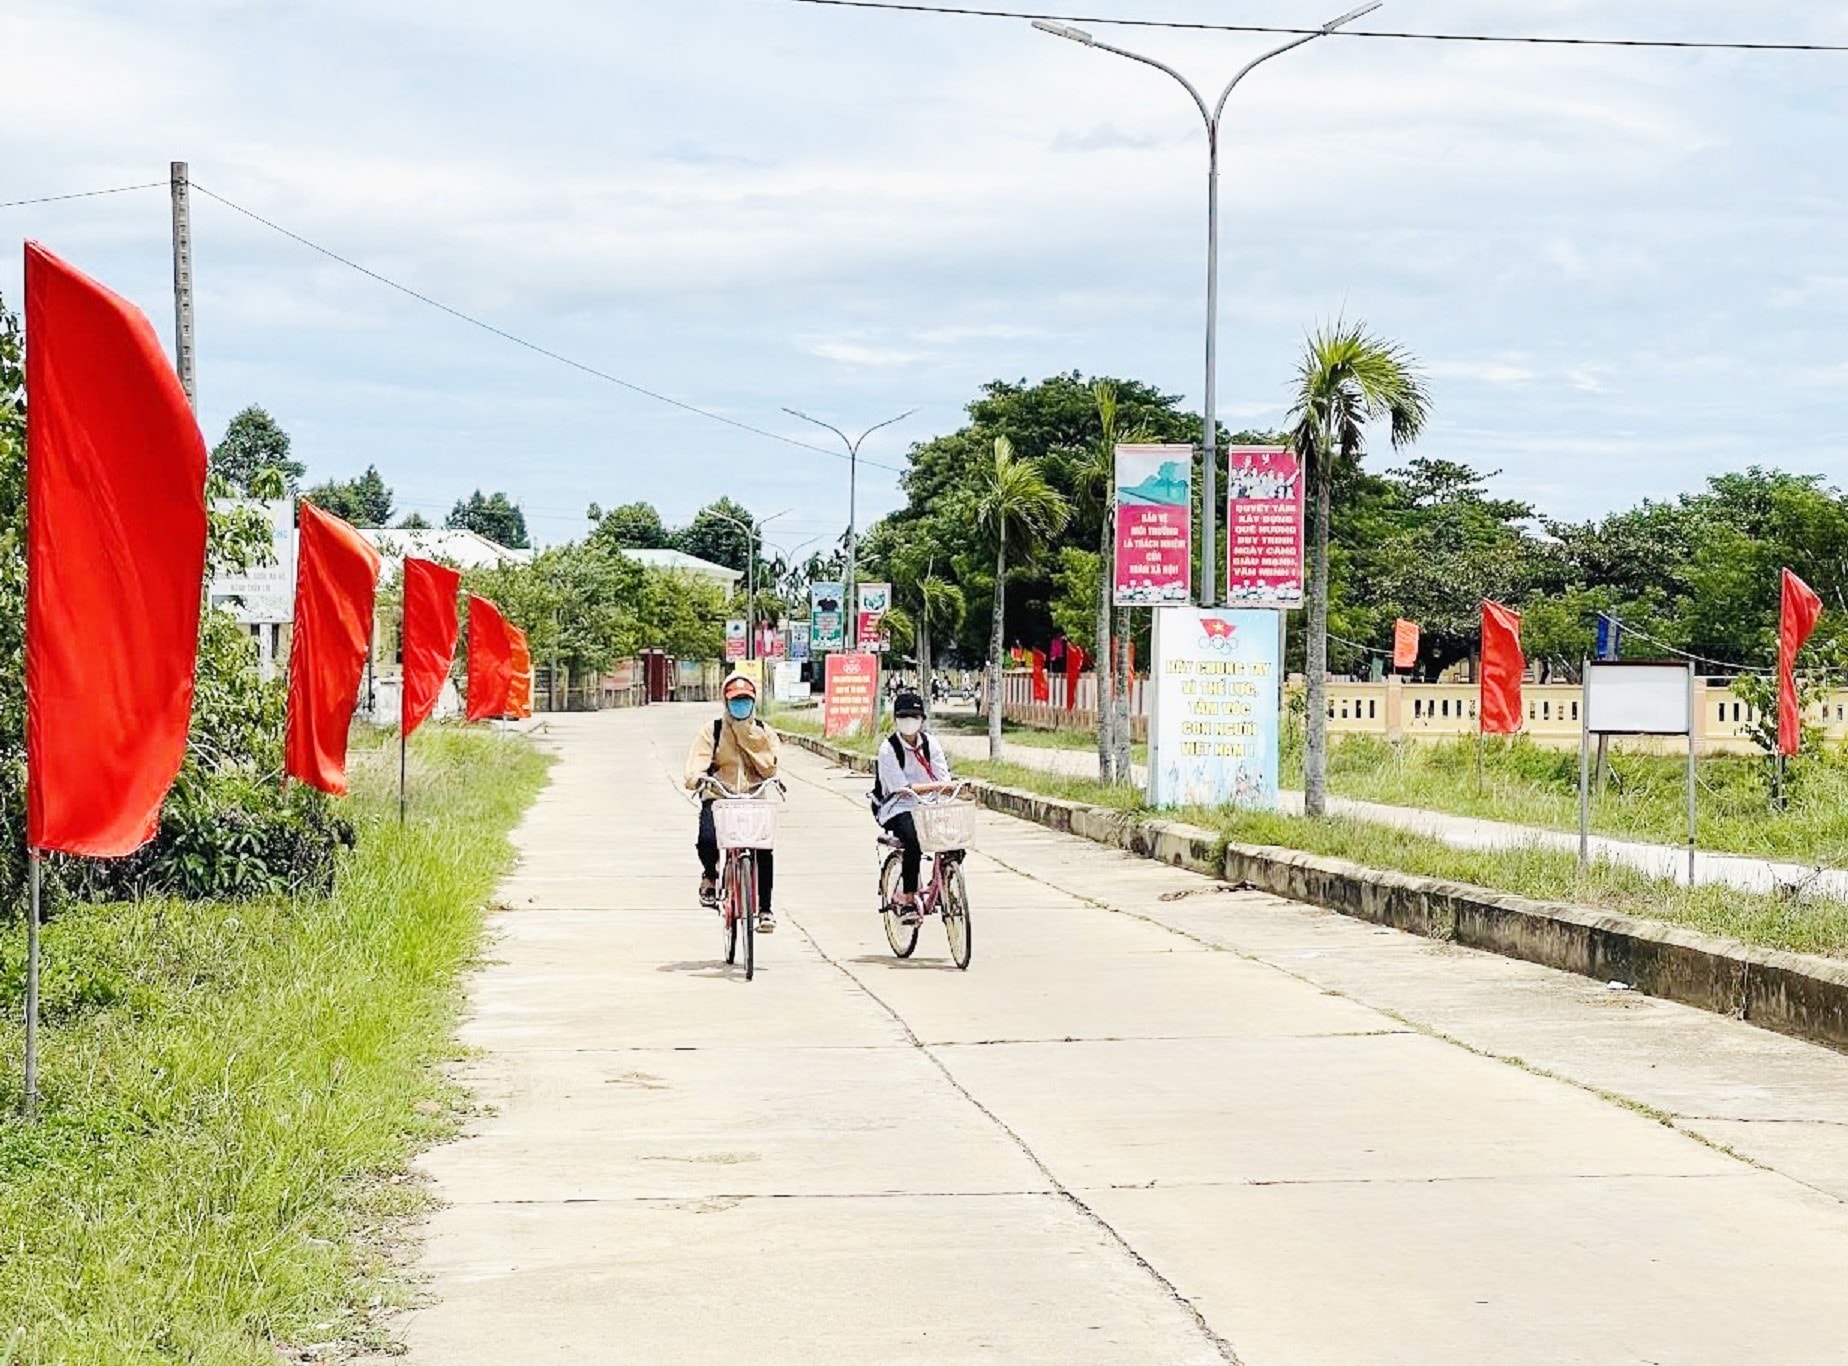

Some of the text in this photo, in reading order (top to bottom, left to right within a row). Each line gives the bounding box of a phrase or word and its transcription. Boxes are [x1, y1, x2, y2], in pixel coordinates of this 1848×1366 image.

[1236, 503, 1296, 513] QUYẾT TÂM
[1239, 514, 1260, 523] XÂY
[1235, 525, 1257, 534] QUÊ
[1258, 567, 1289, 577] MINH
[1165, 659, 1272, 676] HÃY CHUNG TAY
[1201, 678, 1226, 696] THỂ
[1221, 700, 1251, 716] VÓC
[1182, 721, 1258, 736] CON NGƯỜI
[1180, 741, 1211, 757] VIỆT
[1214, 742, 1245, 757] NAM
